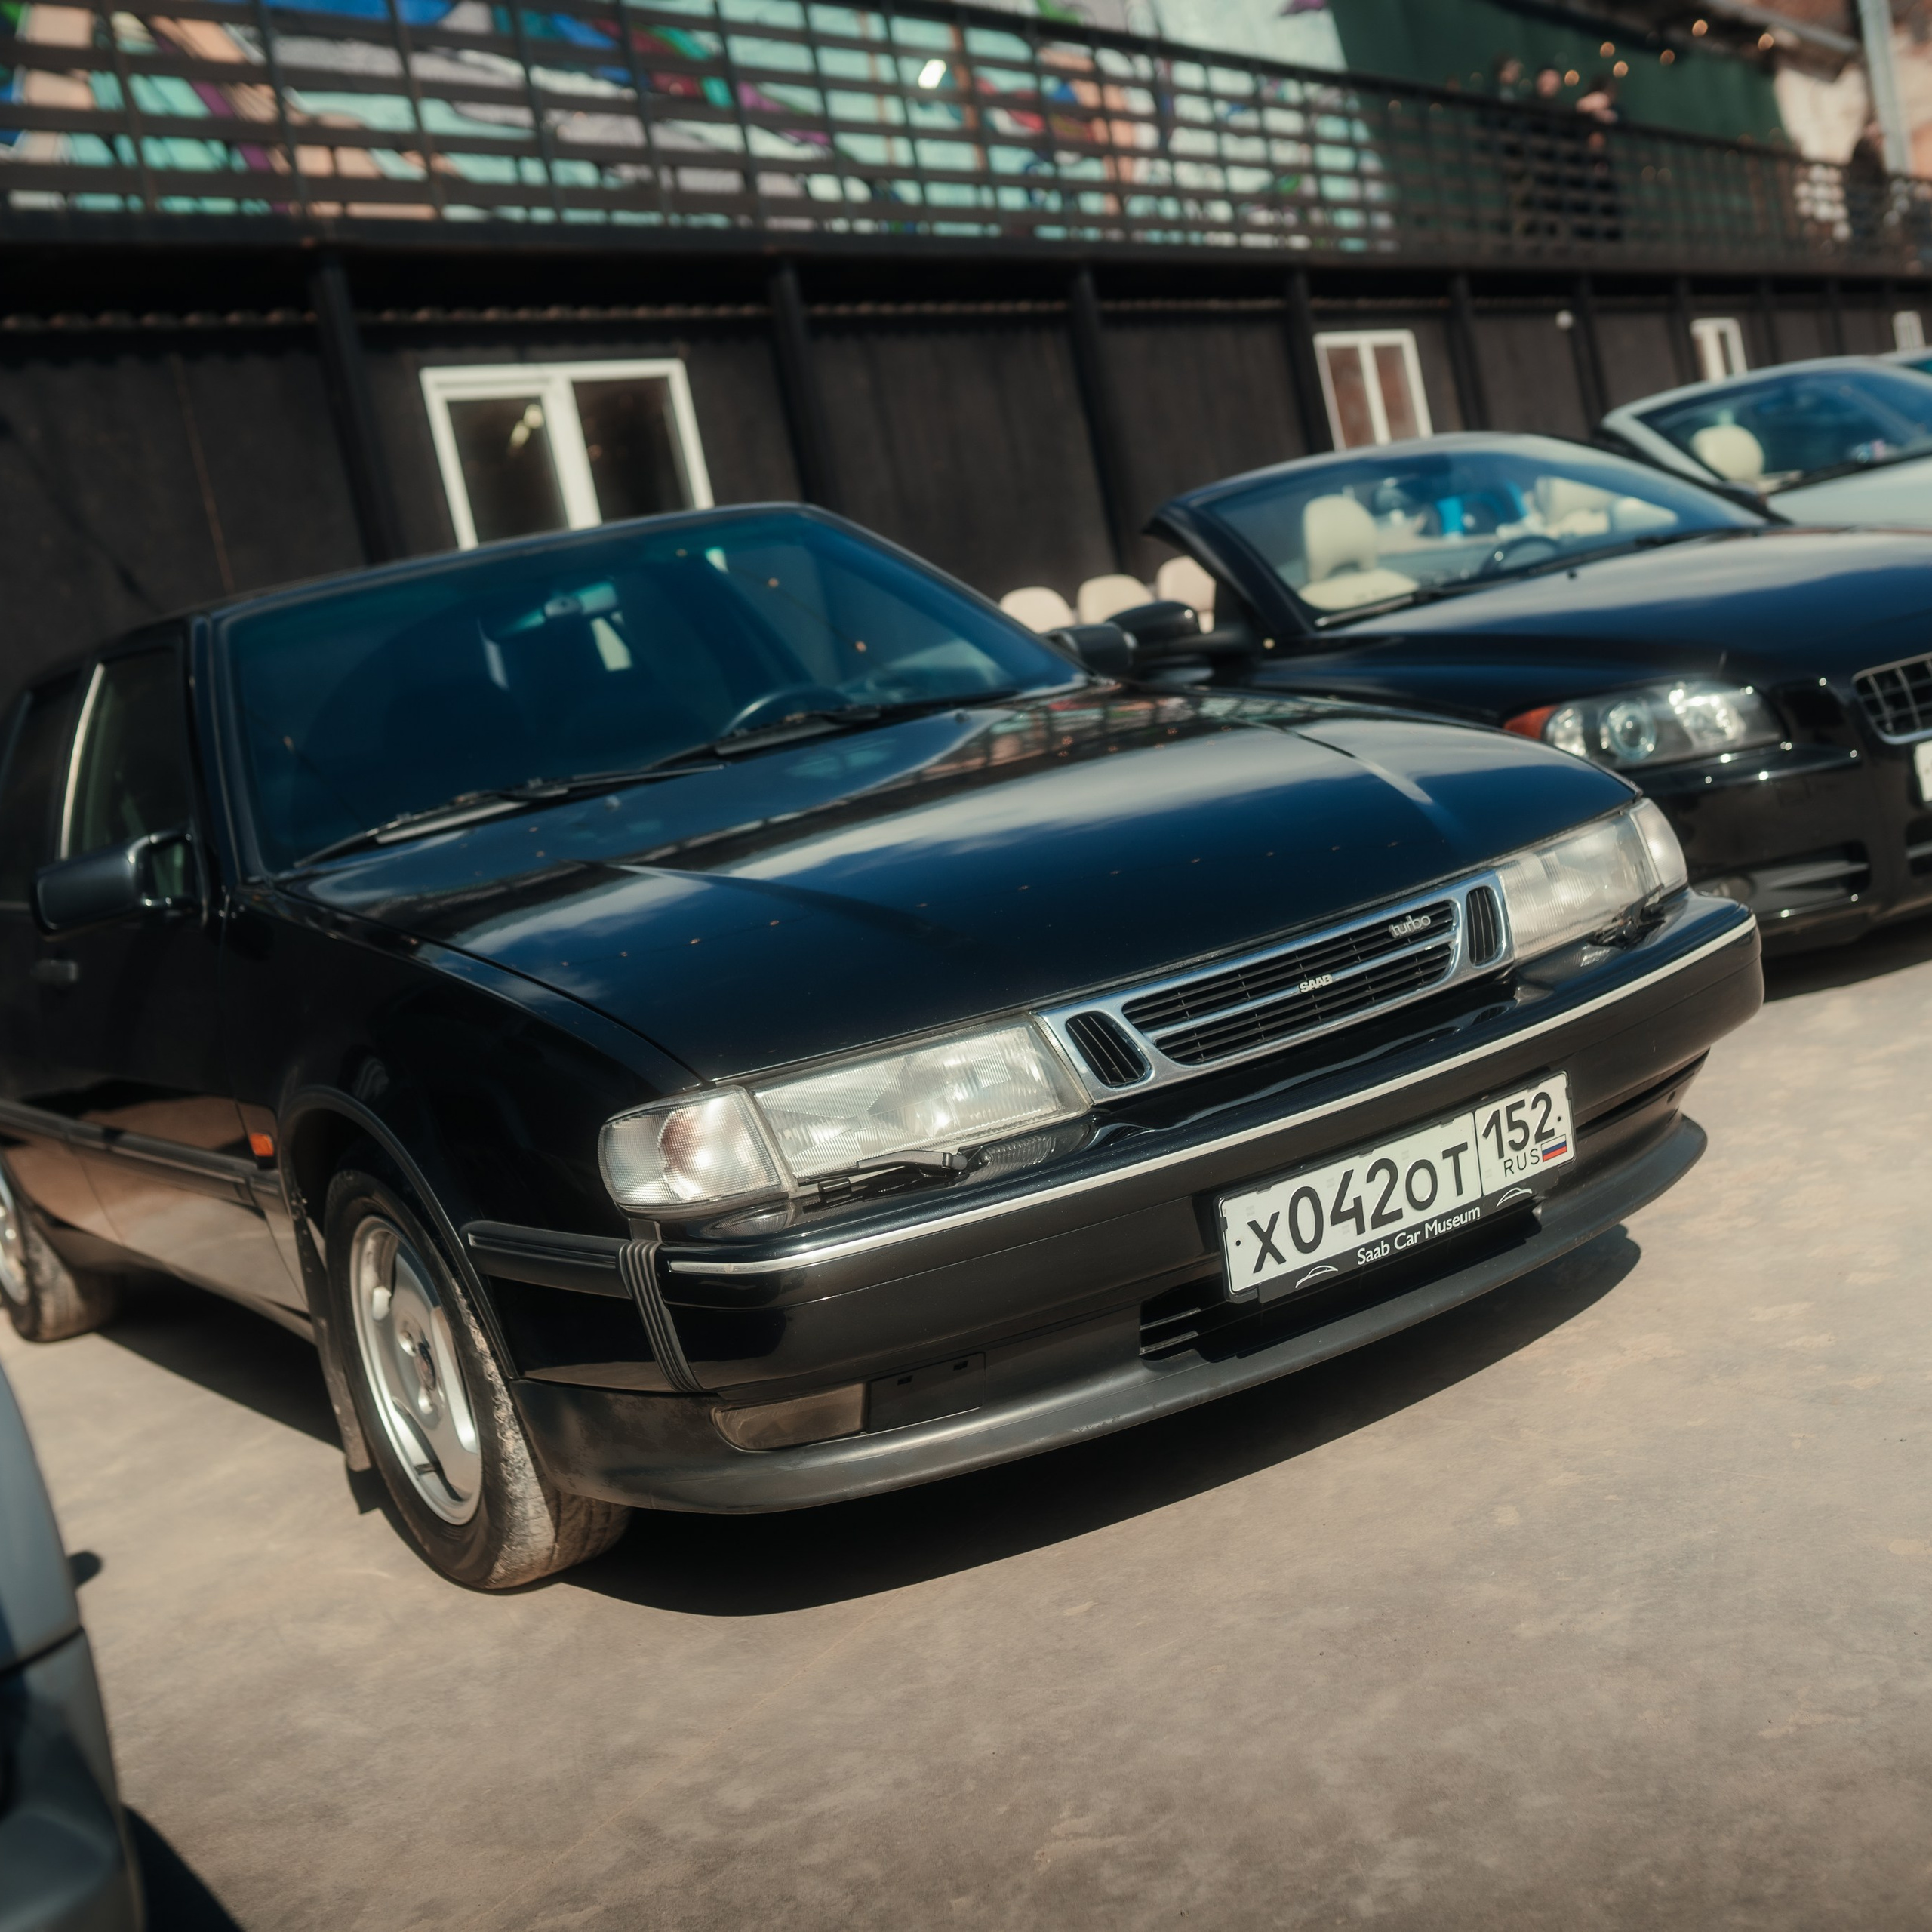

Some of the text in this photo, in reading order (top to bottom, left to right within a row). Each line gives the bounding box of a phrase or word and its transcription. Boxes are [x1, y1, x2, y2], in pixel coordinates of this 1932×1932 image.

[1389, 915, 1431, 938] turbo
[1299, 974, 1333, 993] SAAB
[1481, 1091, 1555, 1160] 152
[1503, 1148, 1540, 1177] RUS
[1357, 1206, 1481, 1265] Saab Car Museum
